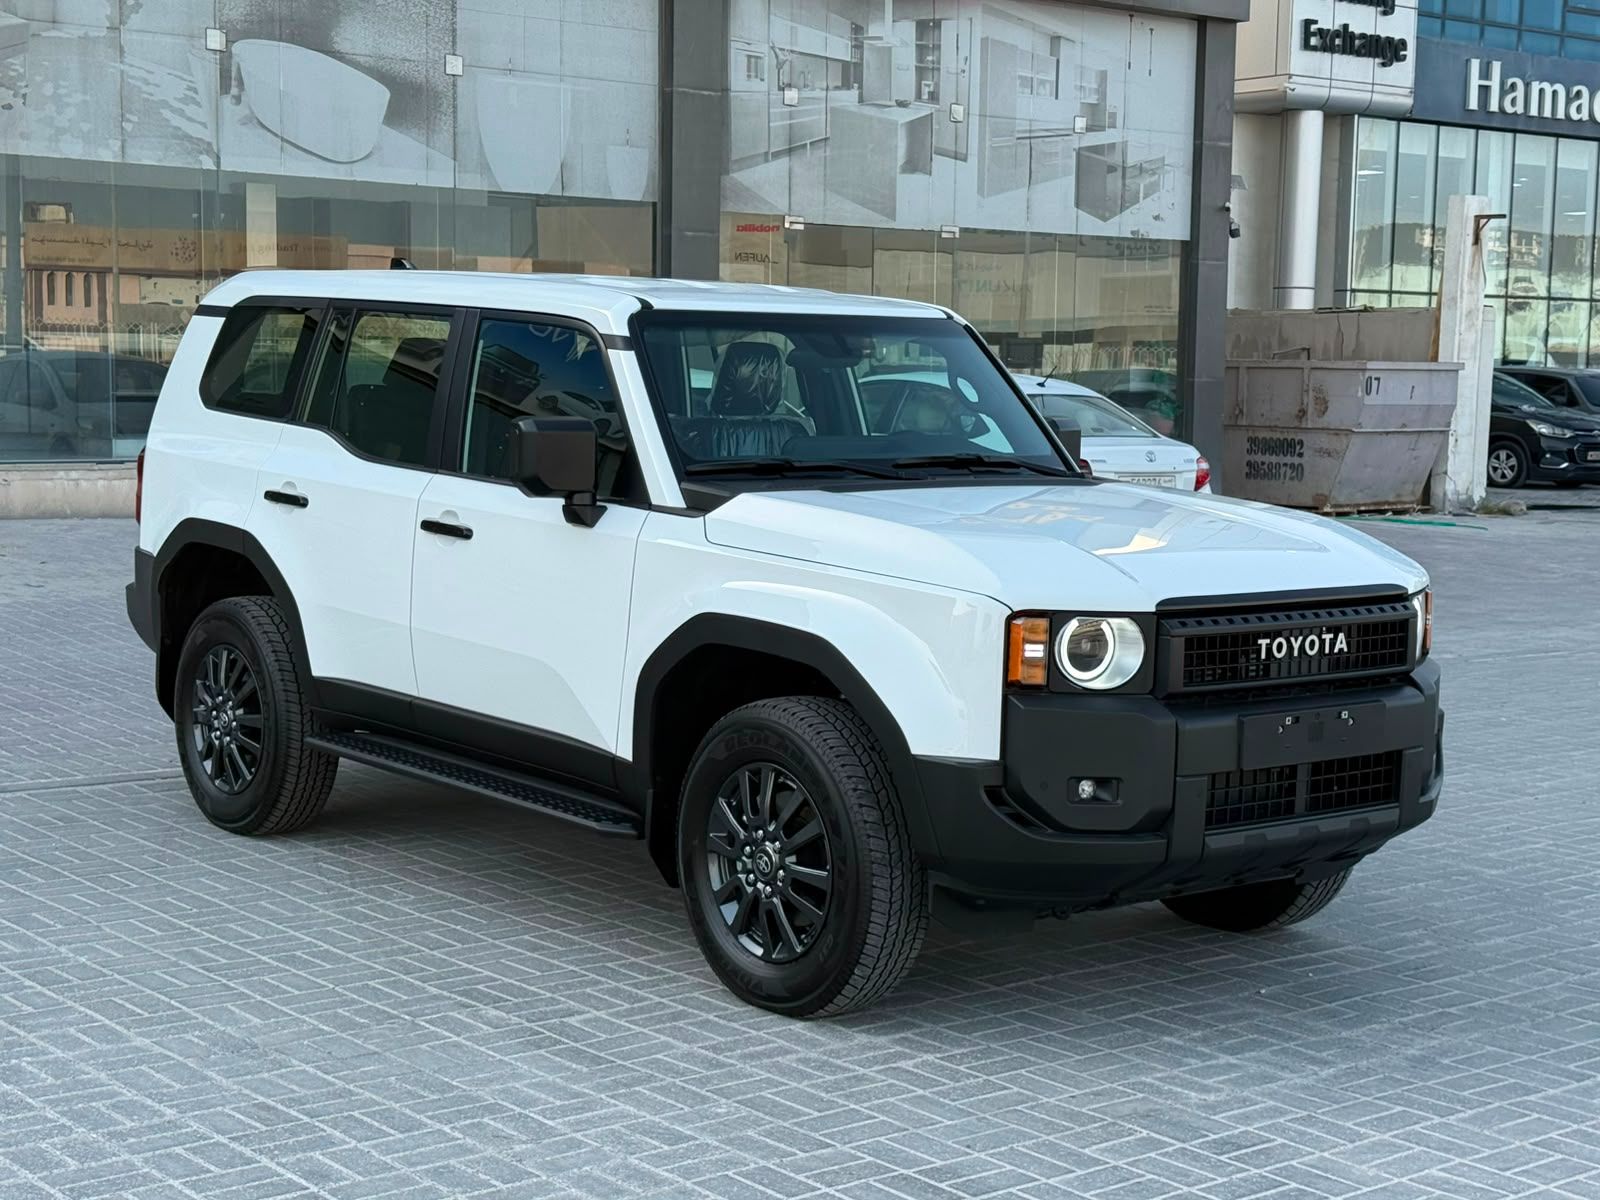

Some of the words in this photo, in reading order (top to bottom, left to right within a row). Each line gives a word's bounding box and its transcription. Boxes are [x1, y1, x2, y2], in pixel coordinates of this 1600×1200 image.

[1301, 18, 1408, 67] Exchange
[1365, 375, 1381, 396] 07
[1257, 632, 1348, 660] TOYOTA
